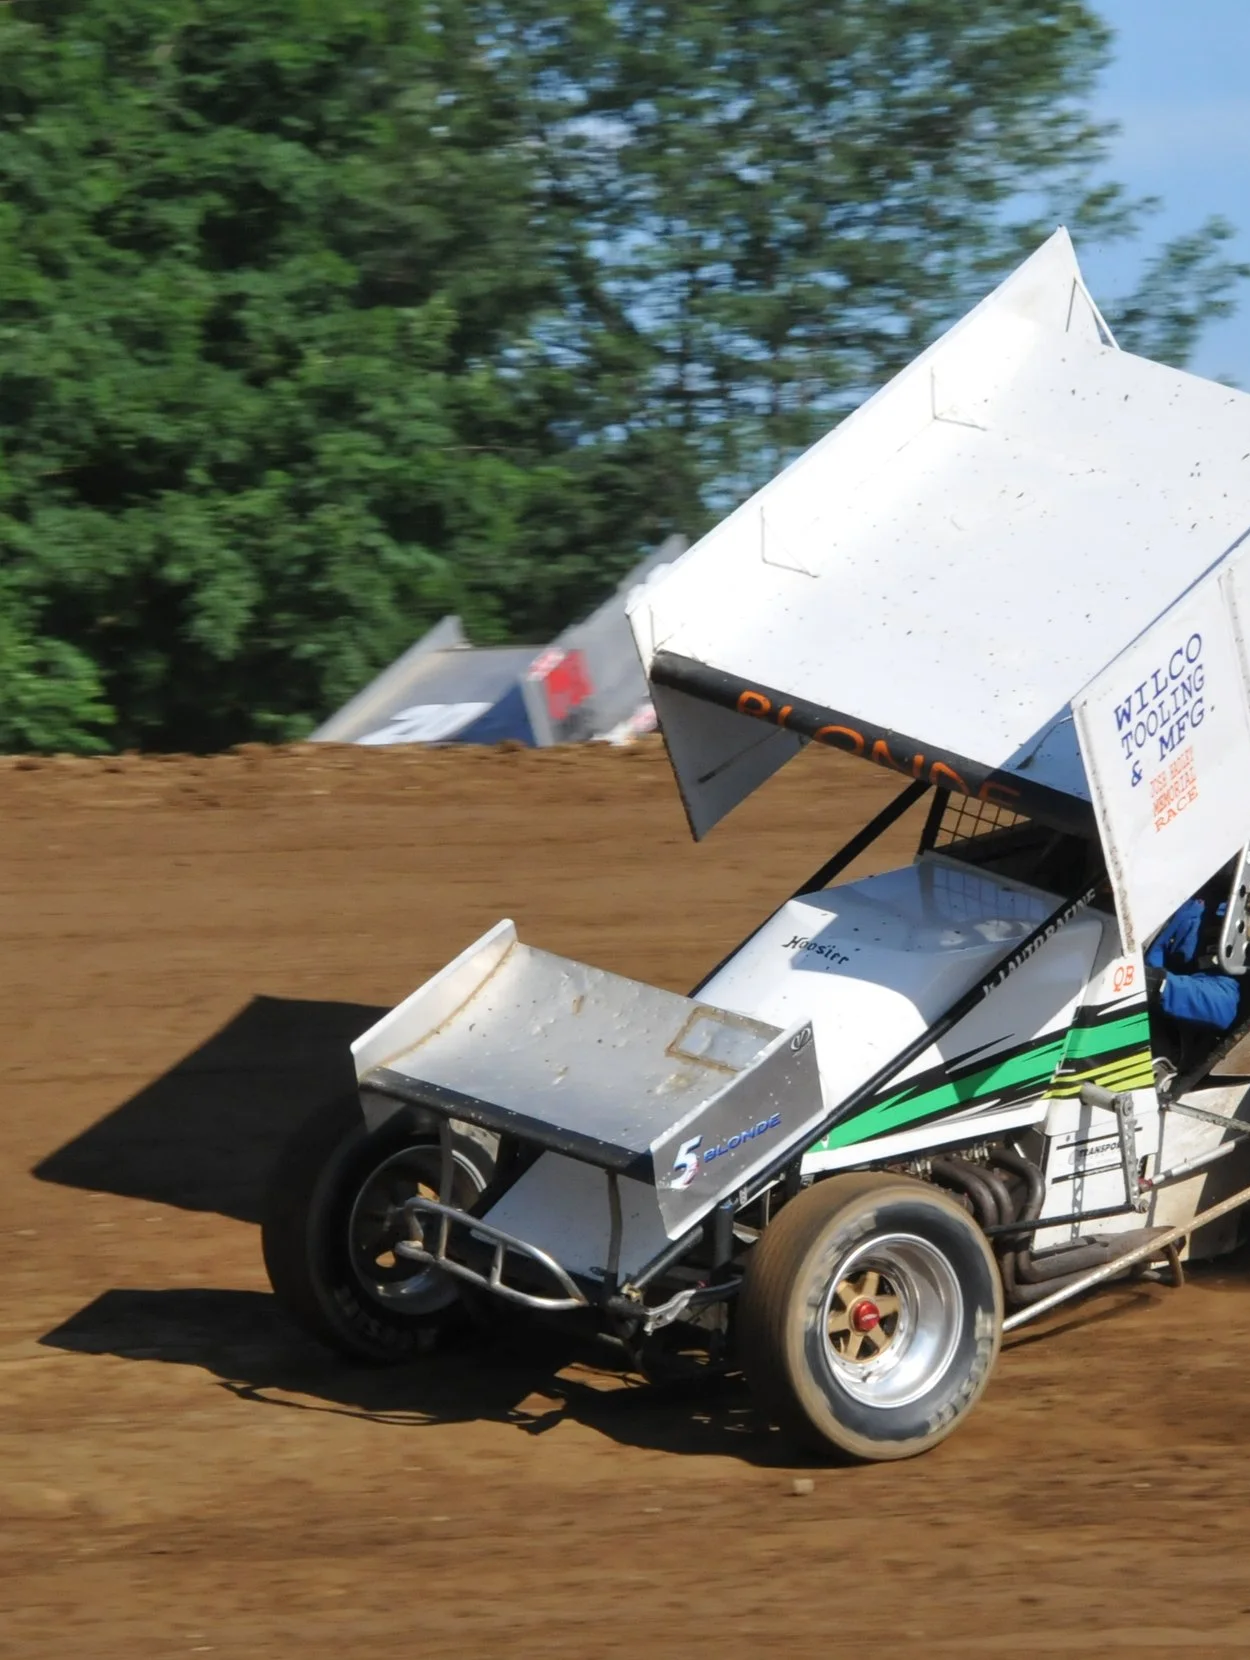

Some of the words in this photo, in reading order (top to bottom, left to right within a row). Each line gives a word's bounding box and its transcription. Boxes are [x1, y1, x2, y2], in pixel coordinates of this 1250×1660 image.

[1114, 633, 1202, 732] WILCO
[1121, 664, 1205, 760] TOOLING
[1131, 759, 1143, 788] &
[1154, 786, 1199, 833] RACE
[781, 935, 850, 965] Hoosier
[1112, 965, 1135, 993] QB
[670, 1134, 703, 1190] 5
[703, 1112, 782, 1163] BLONDE
